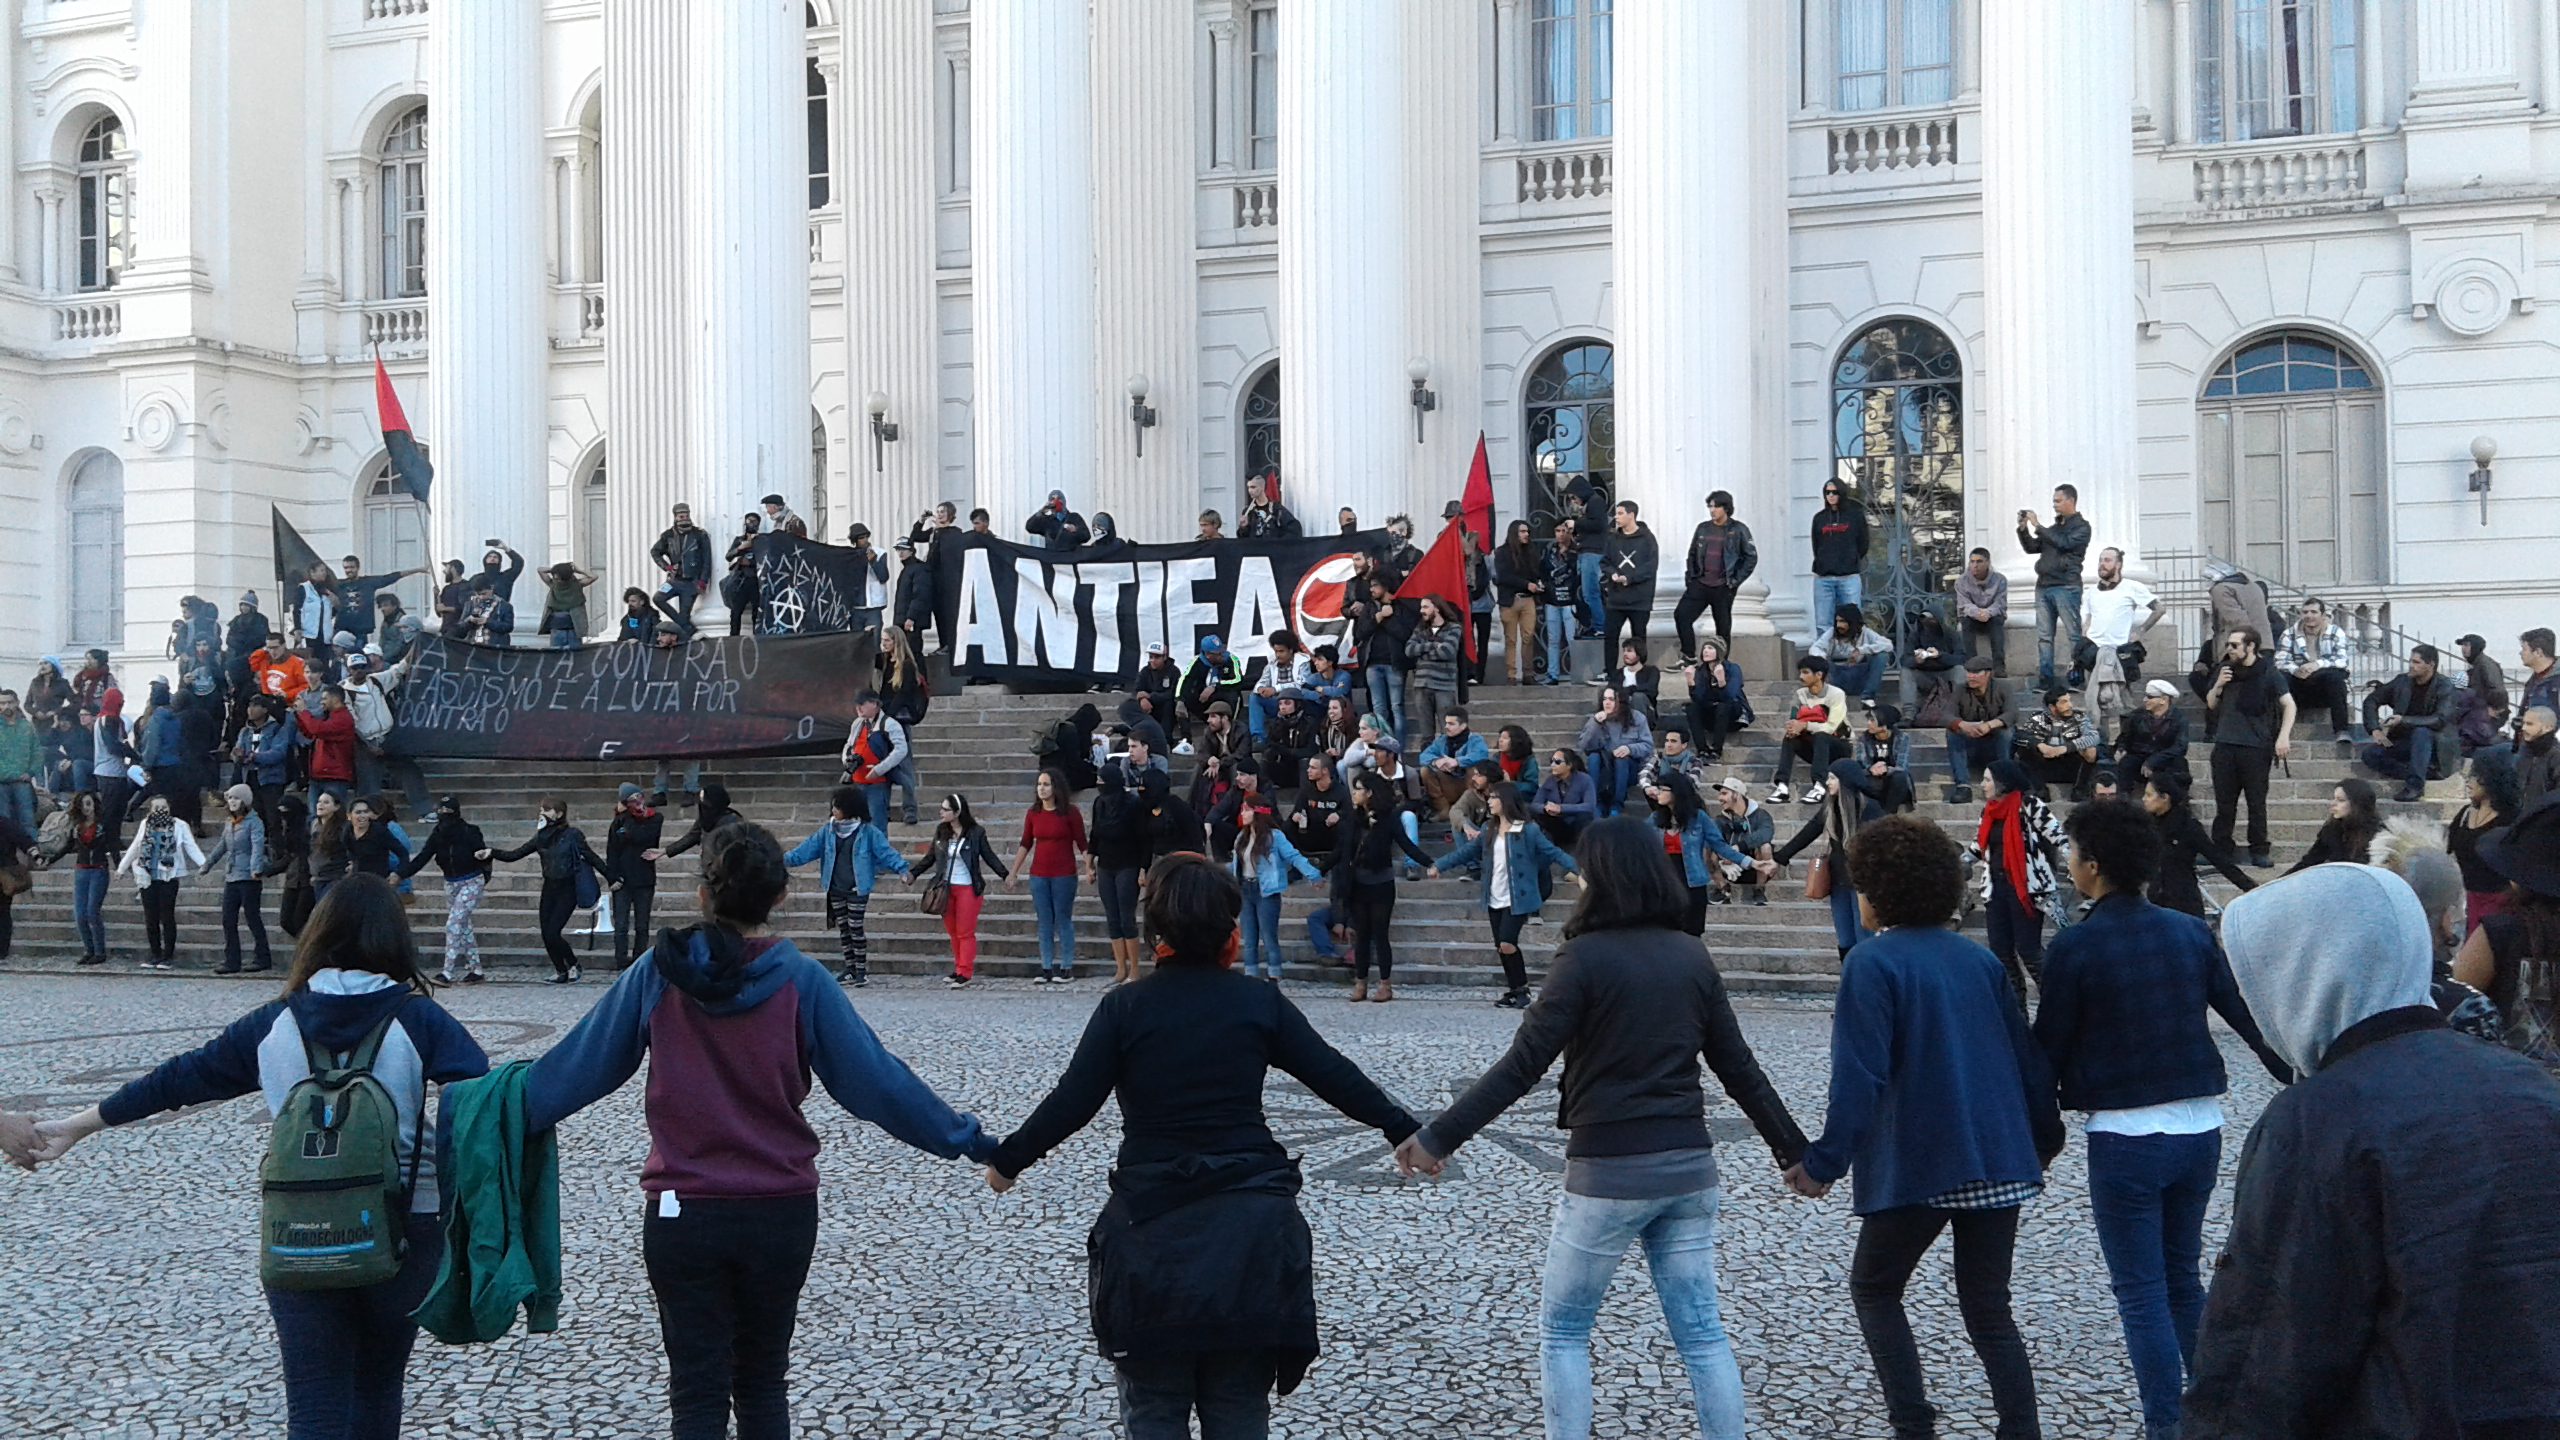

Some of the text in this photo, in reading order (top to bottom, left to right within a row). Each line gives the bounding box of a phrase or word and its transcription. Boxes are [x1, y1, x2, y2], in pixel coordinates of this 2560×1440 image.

[954, 548, 1288, 677] ANTIFA
[415, 633, 760, 681] A LUTA CONTRA O
[405, 663, 543, 711] FASCISMO
[580, 679, 600, 713] A
[607, 679, 681, 713] LUTA
[692, 679, 740, 713] POR
[398, 700, 510, 733] CONTRA O
